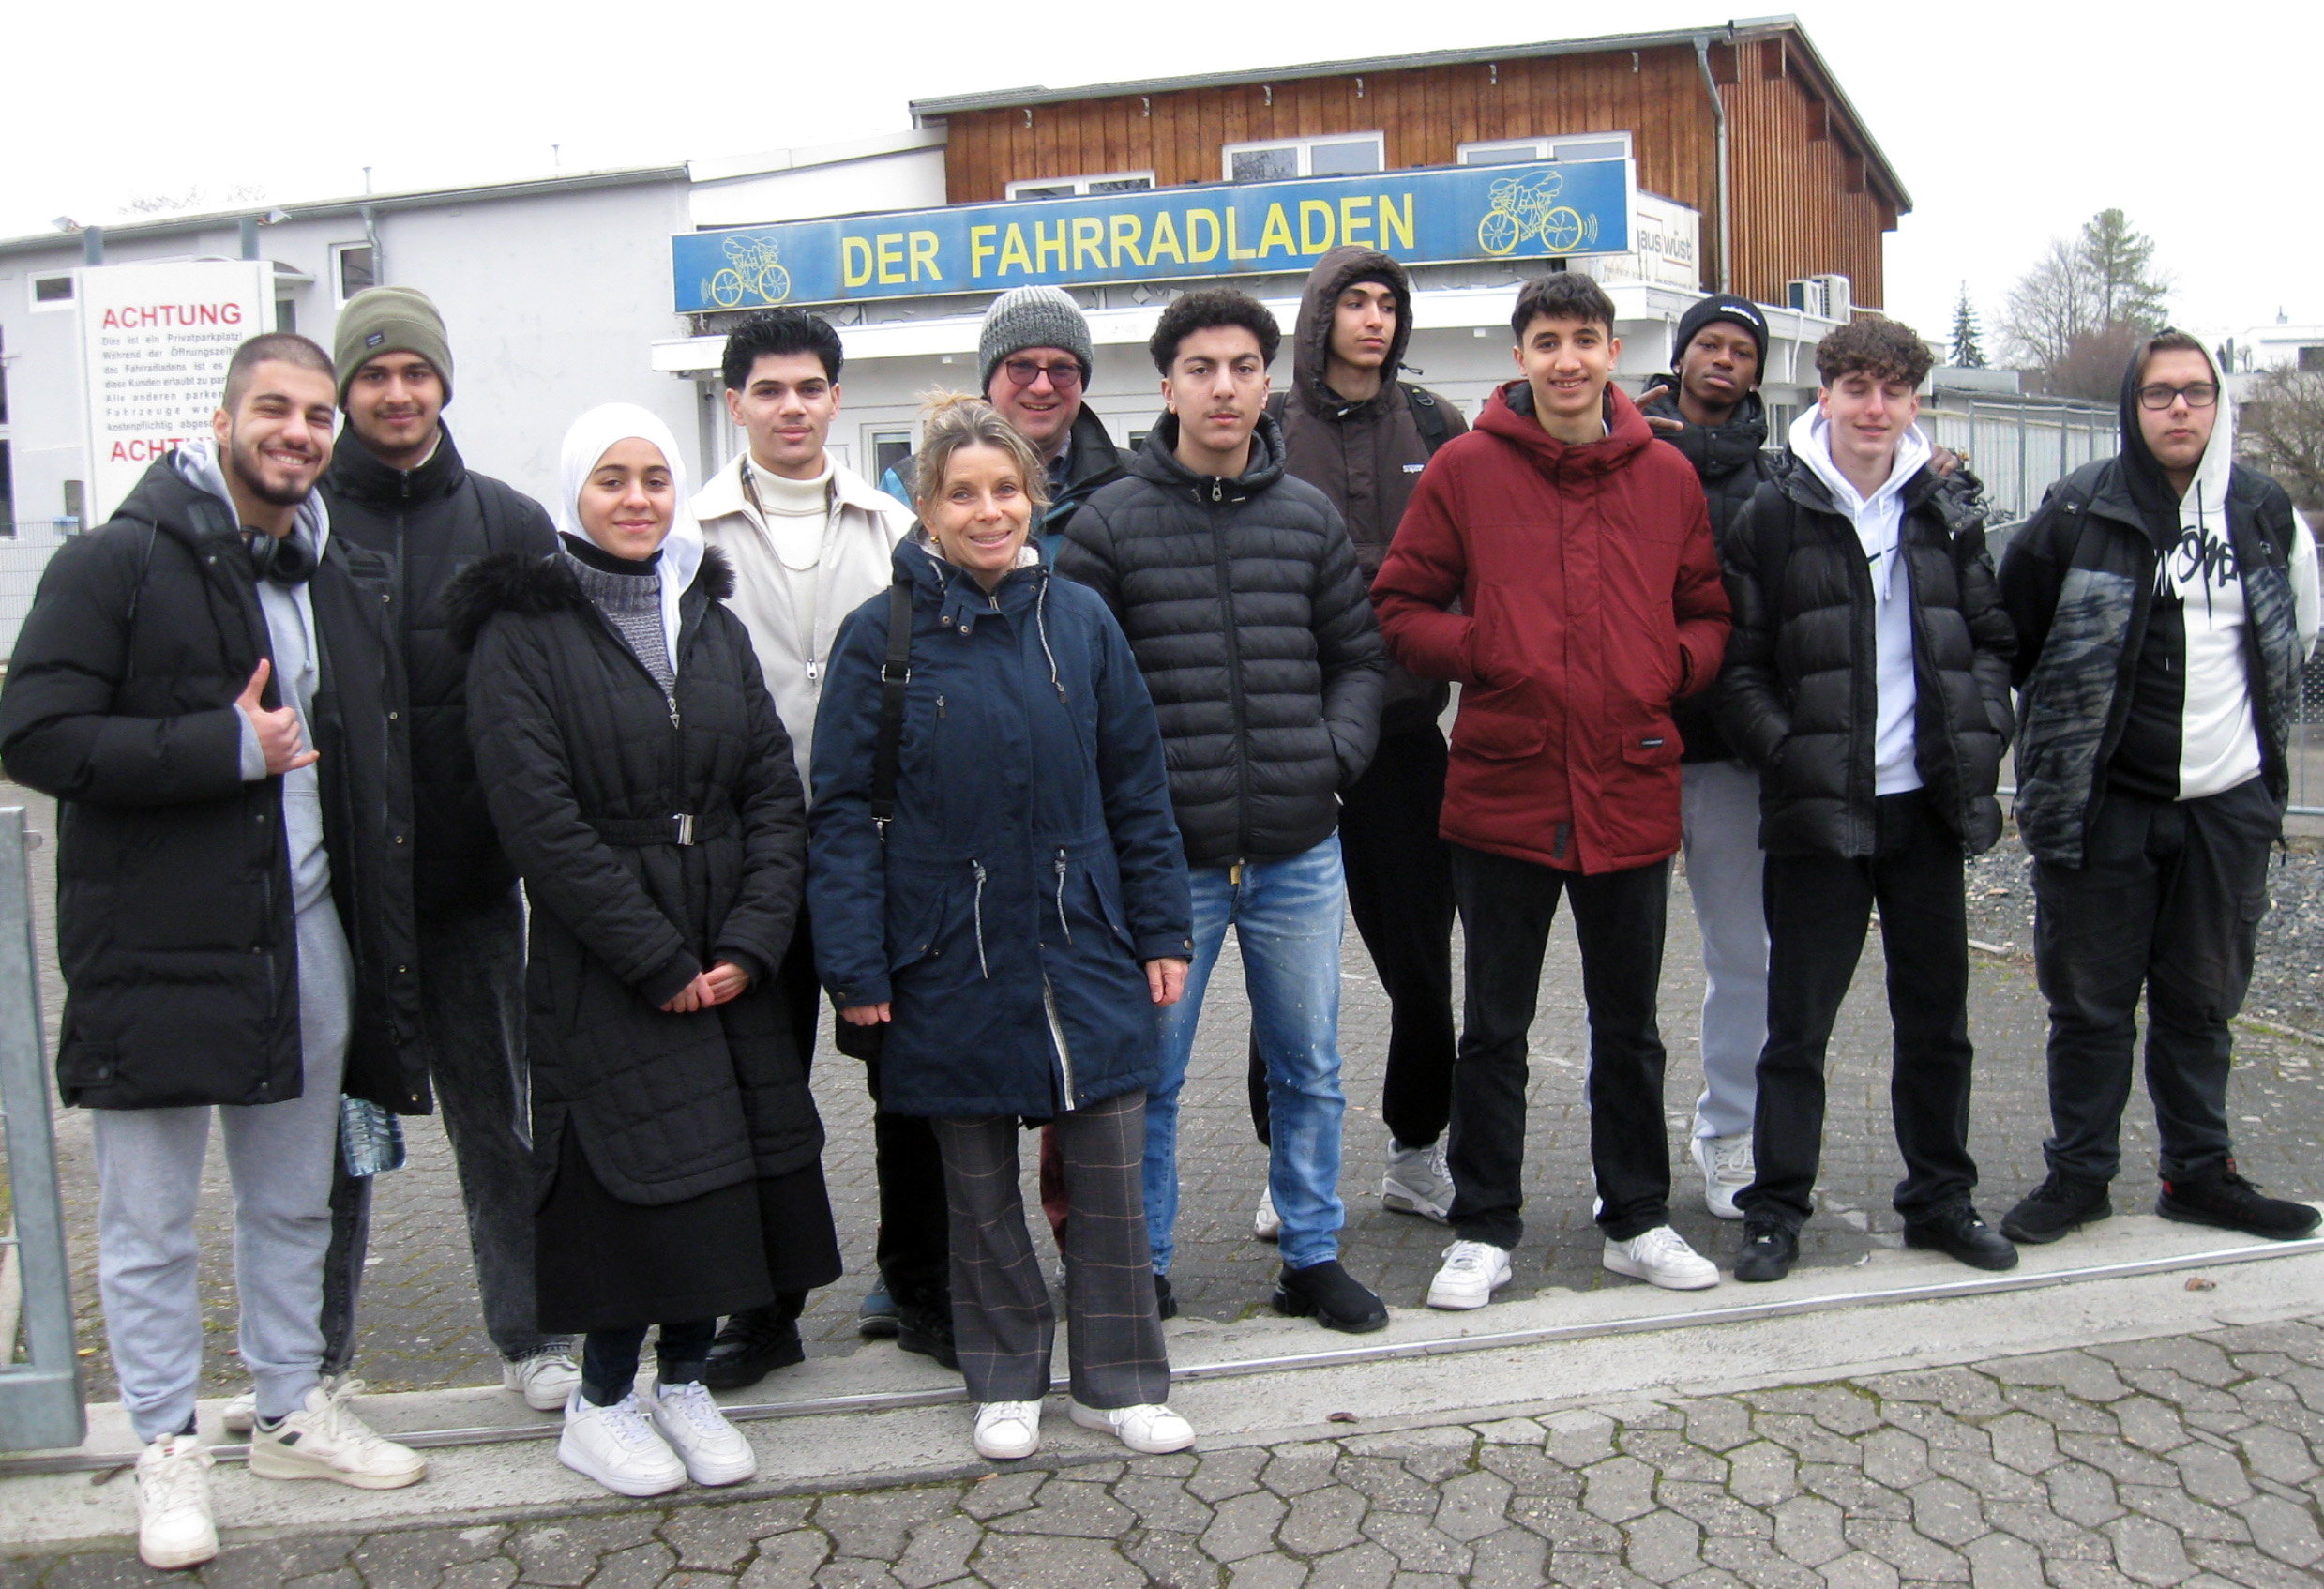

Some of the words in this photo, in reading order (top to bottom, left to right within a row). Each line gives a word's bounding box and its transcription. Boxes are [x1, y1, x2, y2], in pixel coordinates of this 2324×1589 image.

[842, 230, 943, 288] DER
[971, 192, 1414, 278] FAHRRADLADEN
[1637, 227, 1662, 253] aus
[102, 303, 242, 329] ACHTUNG
[102, 337, 121, 345] Dies
[128, 336, 139, 344] ist
[145, 335, 159, 343] ein
[167, 332, 243, 344] Privatparkplatz!
[103, 350, 141, 359] Während
[171, 346, 237, 357] Öffnungszeite
[125, 363, 187, 373] Fahrradladens
[194, 362, 205, 371] ist
[128, 378, 161, 387] Kunden
[163, 377, 195, 386] erlaubt
[210, 377, 226, 386] par
[106, 394, 126, 402] Alle
[133, 392, 176, 401] anderen
[186, 390, 223, 401] parken
[107, 407, 181, 416] Fahrzeuge
[107, 420, 173, 431] kostenpflichtig
[180, 420, 214, 431] abgesc
[111, 437, 212, 462] ACHT
